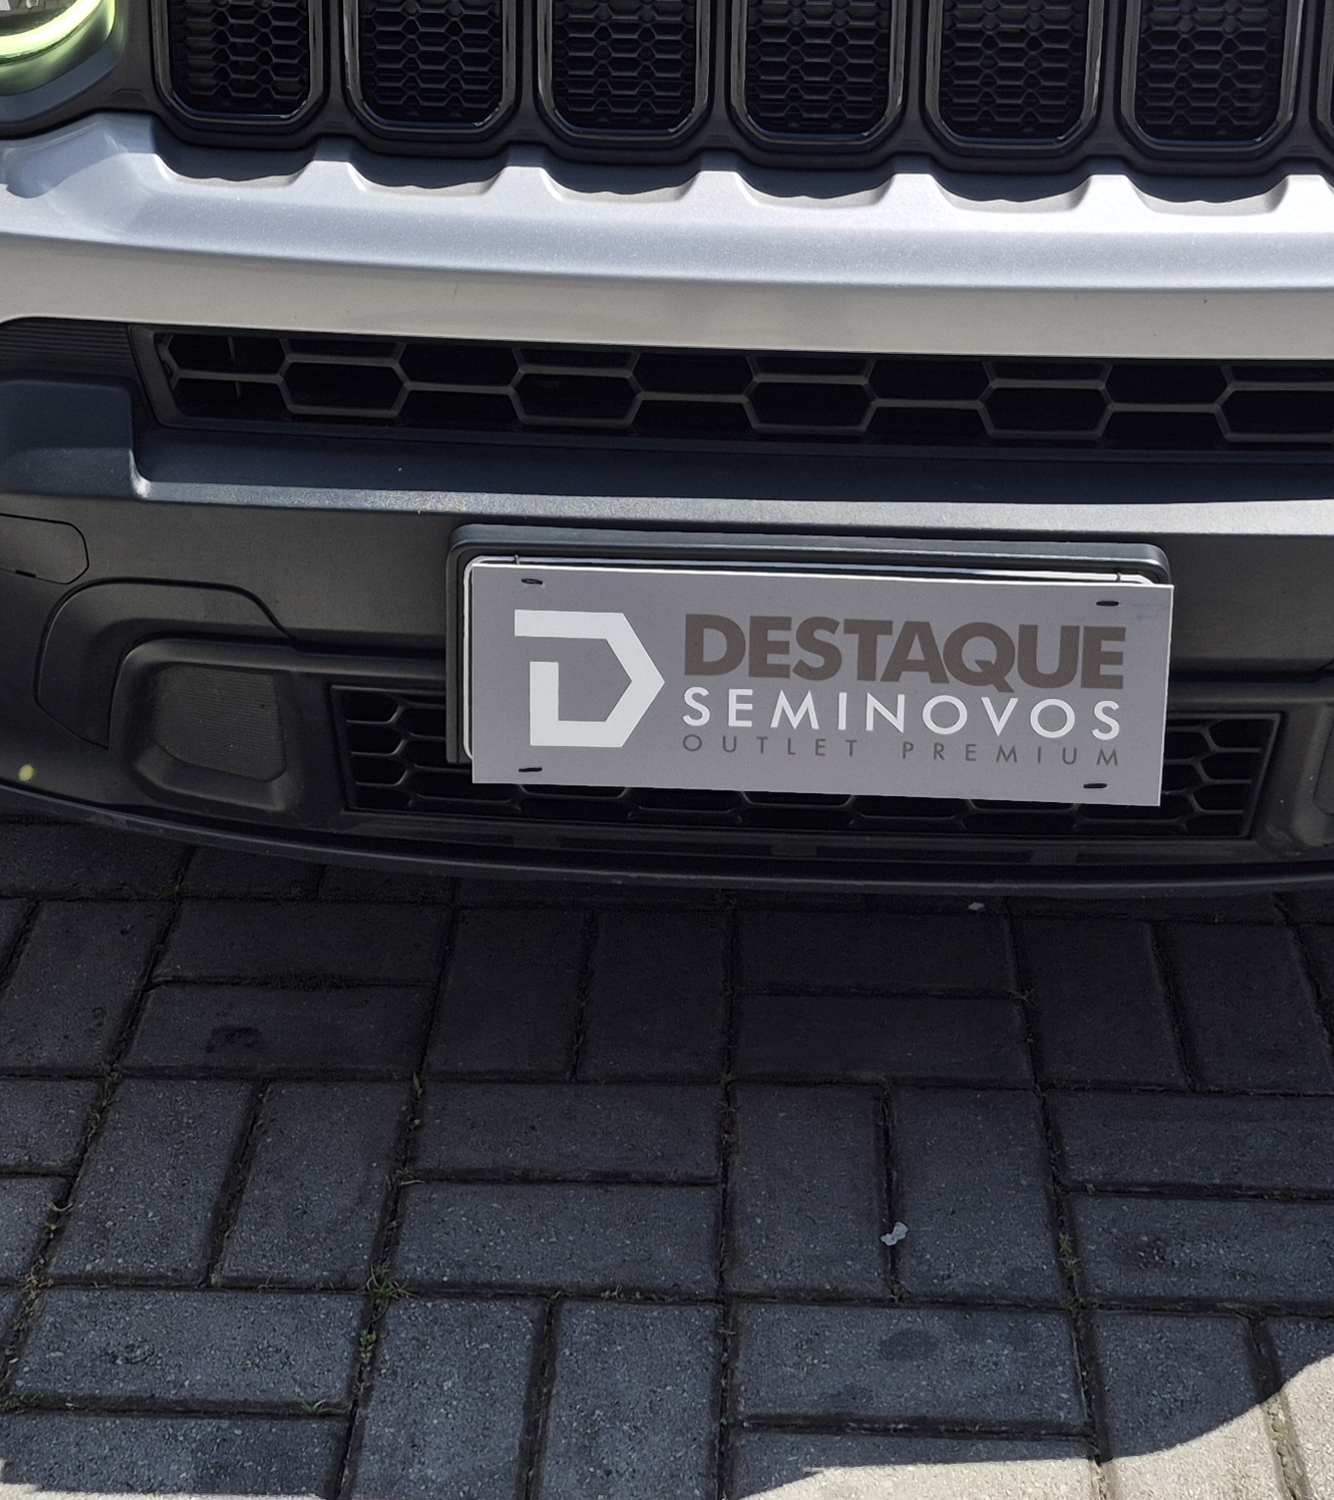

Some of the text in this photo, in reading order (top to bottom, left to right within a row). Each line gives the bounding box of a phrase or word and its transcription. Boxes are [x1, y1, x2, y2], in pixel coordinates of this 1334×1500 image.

[683, 613, 1127, 694] DESTAQUE
[682, 686, 1121, 741] SEMINOVOS
[682, 733, 1119, 767] OUTLET PREMIUM
